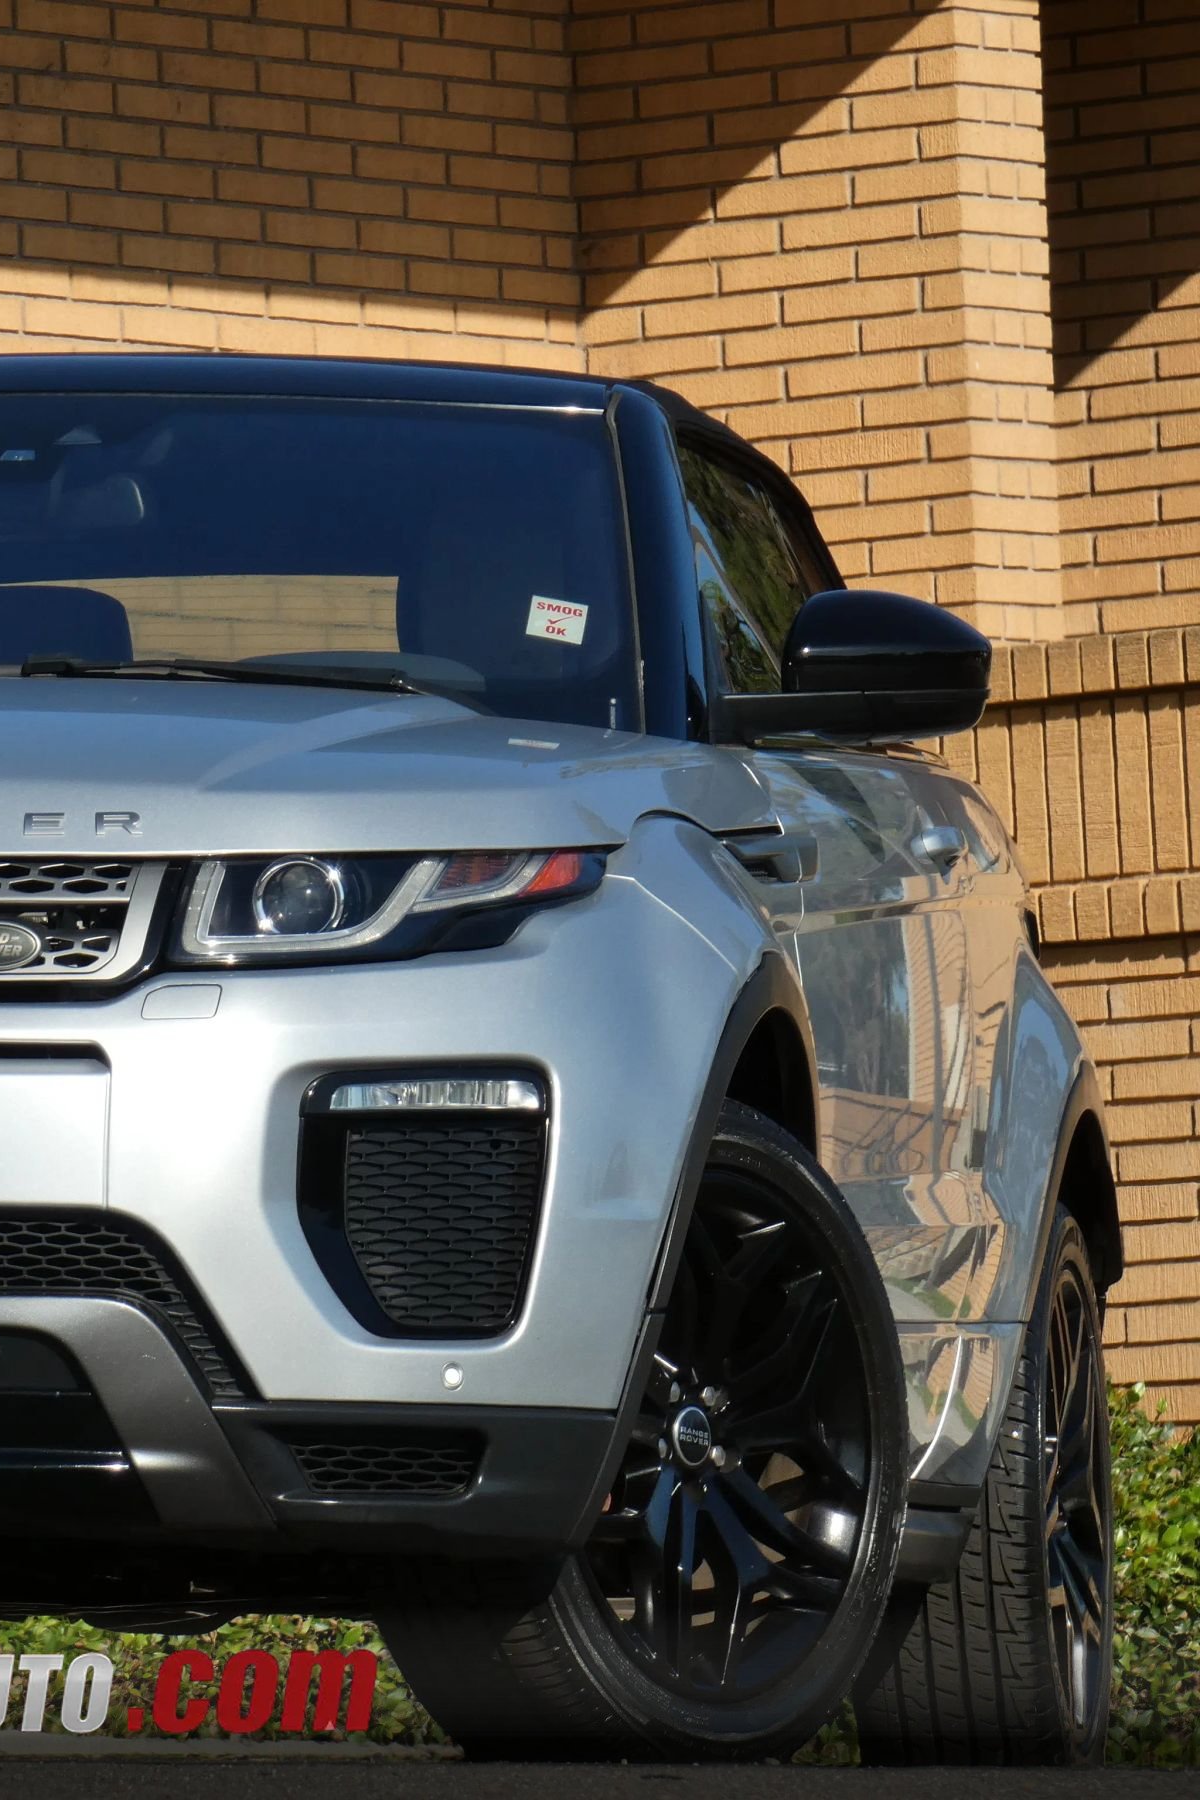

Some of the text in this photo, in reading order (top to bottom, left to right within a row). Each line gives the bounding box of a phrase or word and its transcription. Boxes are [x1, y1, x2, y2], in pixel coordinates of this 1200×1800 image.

[536, 601, 583, 617] SMOG
[545, 625, 566, 636] OK
[680, 1426, 709, 1439] RANGE
[680, 1434, 709, 1446] ROVER
